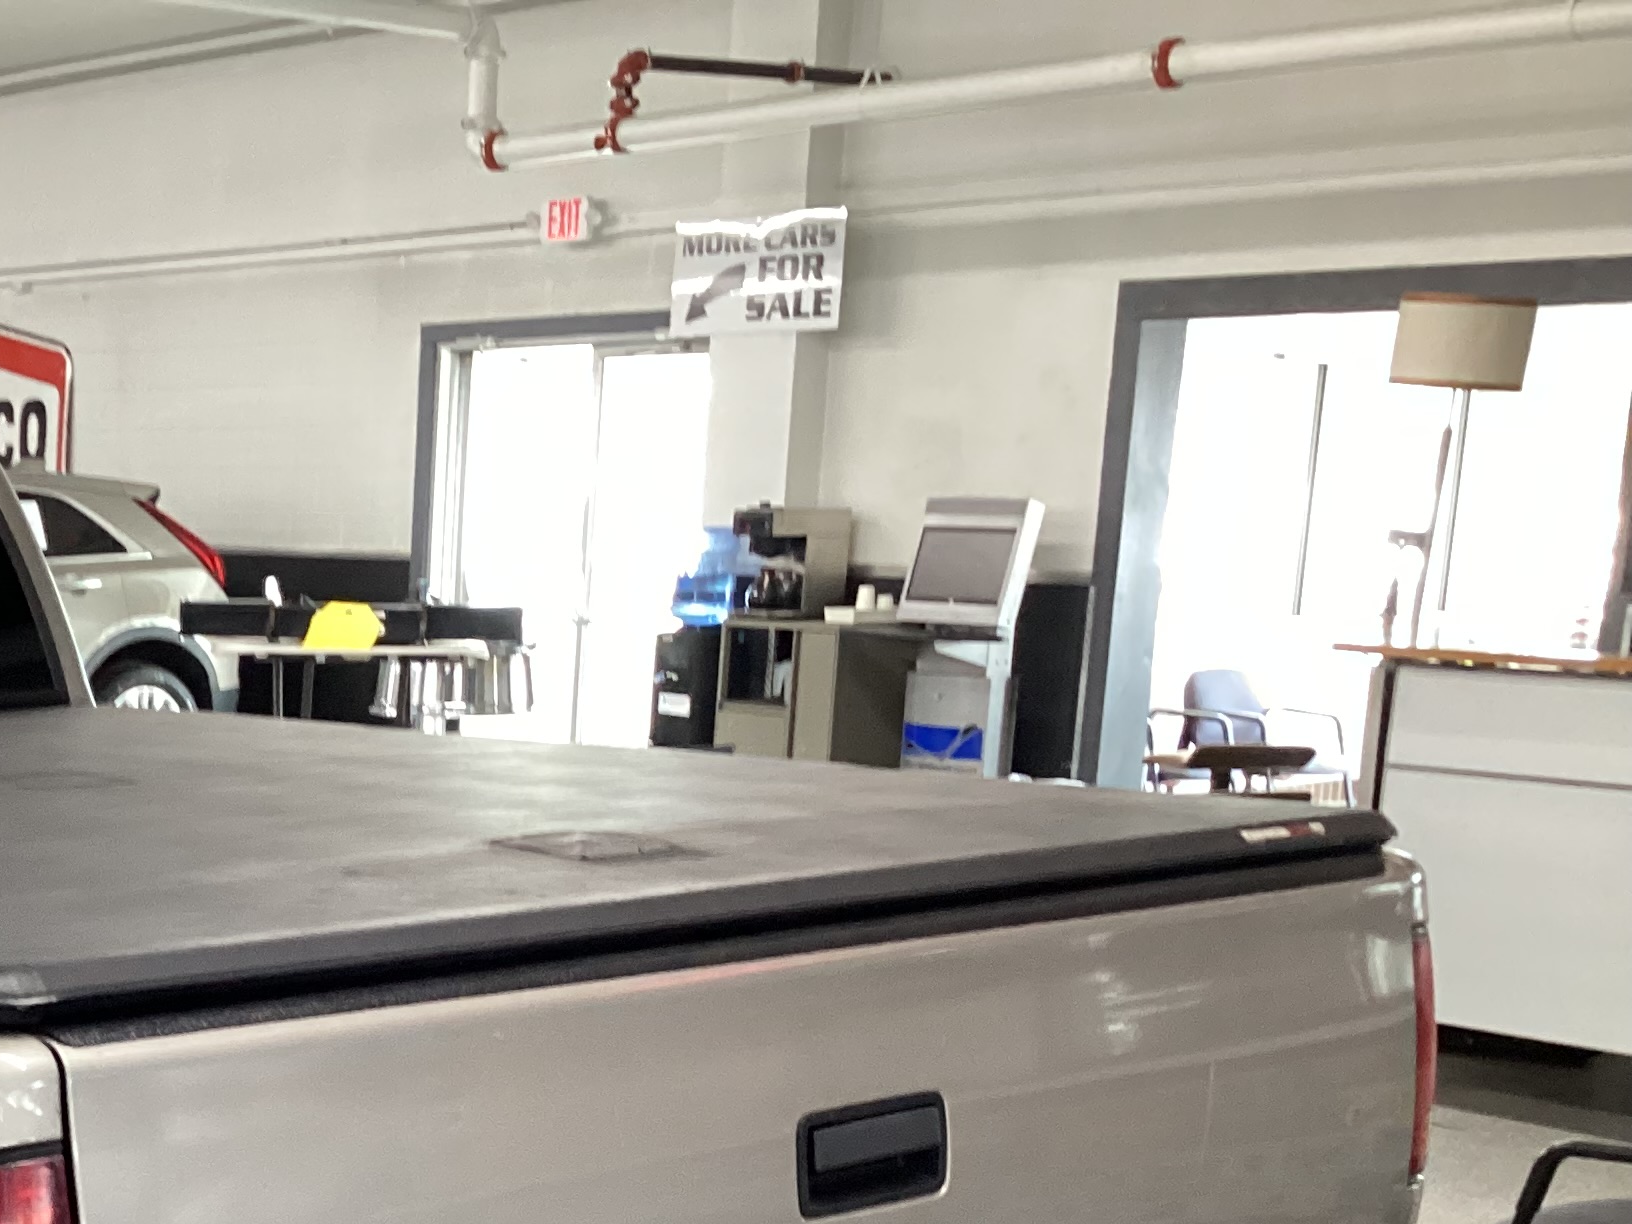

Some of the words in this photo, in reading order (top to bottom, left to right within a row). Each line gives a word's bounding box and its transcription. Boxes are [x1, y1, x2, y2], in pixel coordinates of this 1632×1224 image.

[548, 198, 581, 239] EXIT
[683, 231, 758, 257] MORE
[764, 223, 836, 250] CARS
[757, 252, 825, 282] FOR
[744, 287, 833, 322] SALE
